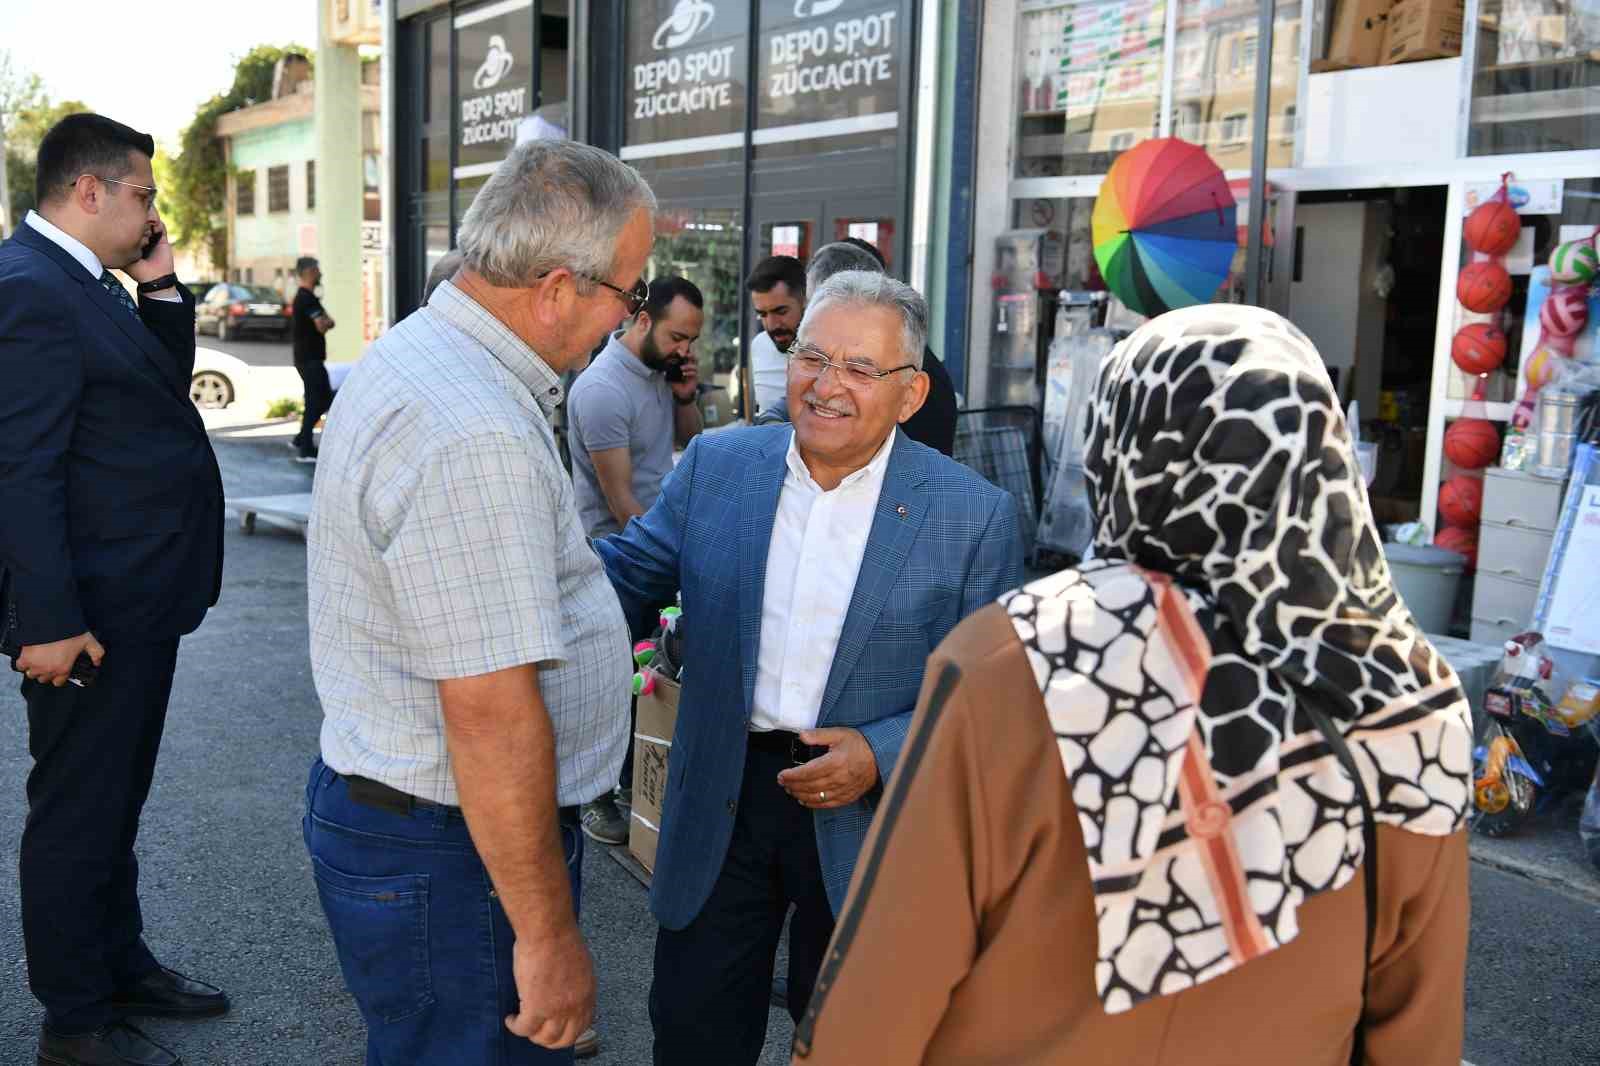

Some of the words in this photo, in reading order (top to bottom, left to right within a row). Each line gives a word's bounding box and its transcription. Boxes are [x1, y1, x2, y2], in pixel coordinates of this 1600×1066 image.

[771, 26, 829, 65] DEPO
[833, 11, 896, 55] SPOT
[634, 57, 681, 91] DEPO
[684, 46, 734, 82] SPOT
[769, 52, 892, 98] ZÜCCACİYE
[462, 94, 493, 122] DEPO
[493, 87, 526, 117] SPOT
[634, 80, 731, 119] ZÜCCACİYE
